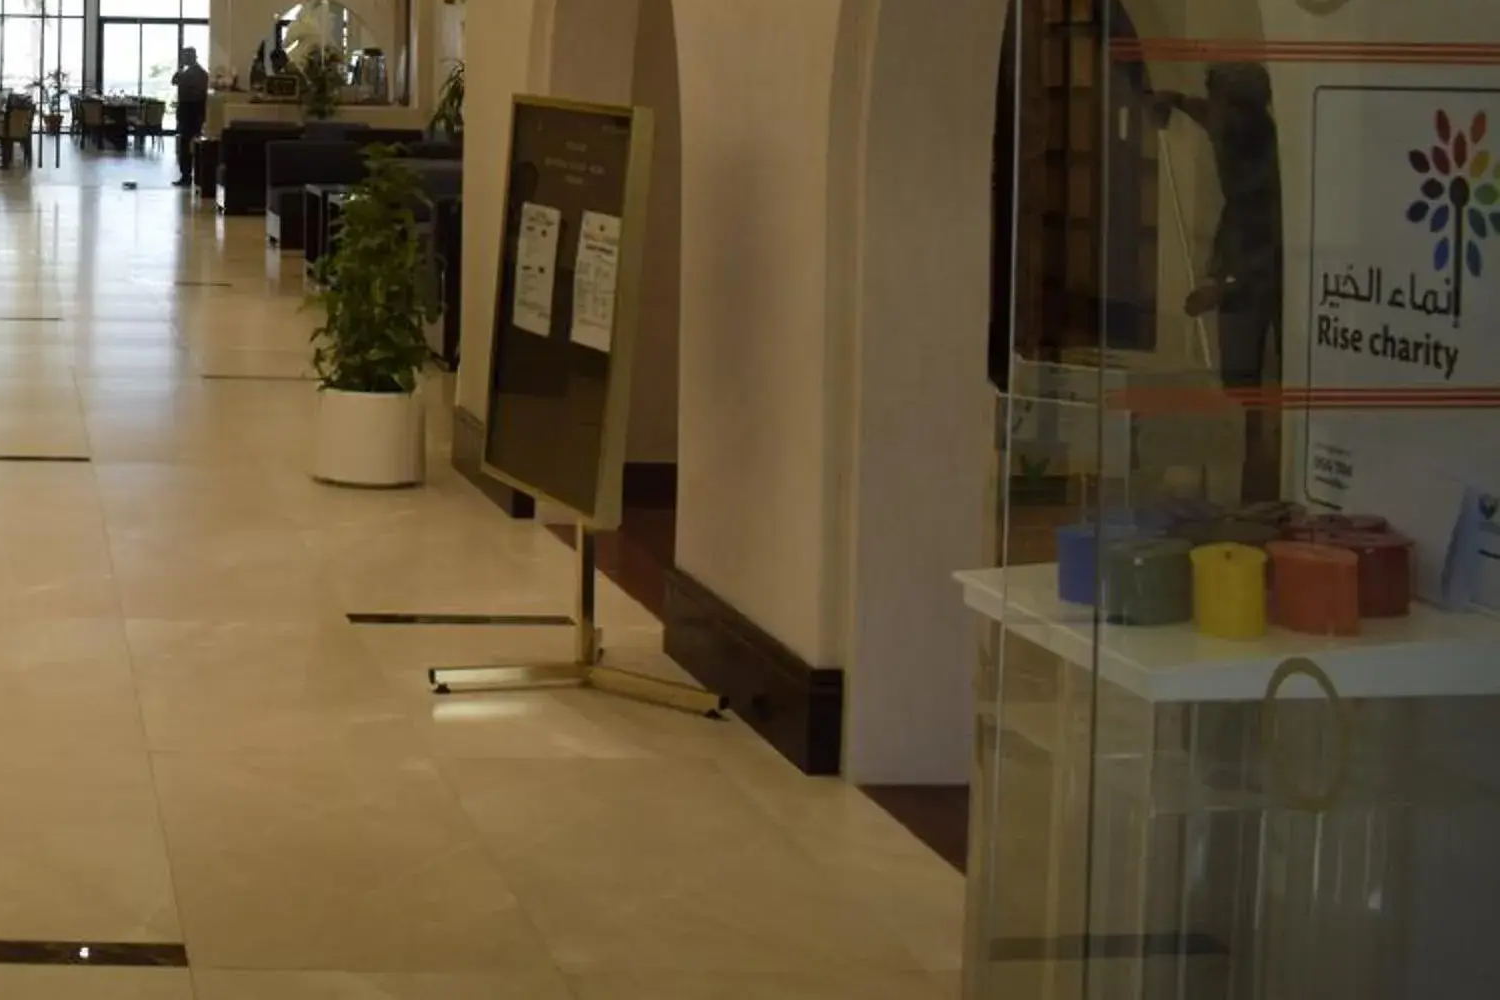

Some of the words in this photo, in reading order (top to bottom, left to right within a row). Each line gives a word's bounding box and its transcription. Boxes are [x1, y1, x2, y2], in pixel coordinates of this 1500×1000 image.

[1319, 264, 1382, 308] الخير
[1317, 314, 1363, 353] Rise
[1369, 324, 1459, 380] charity
